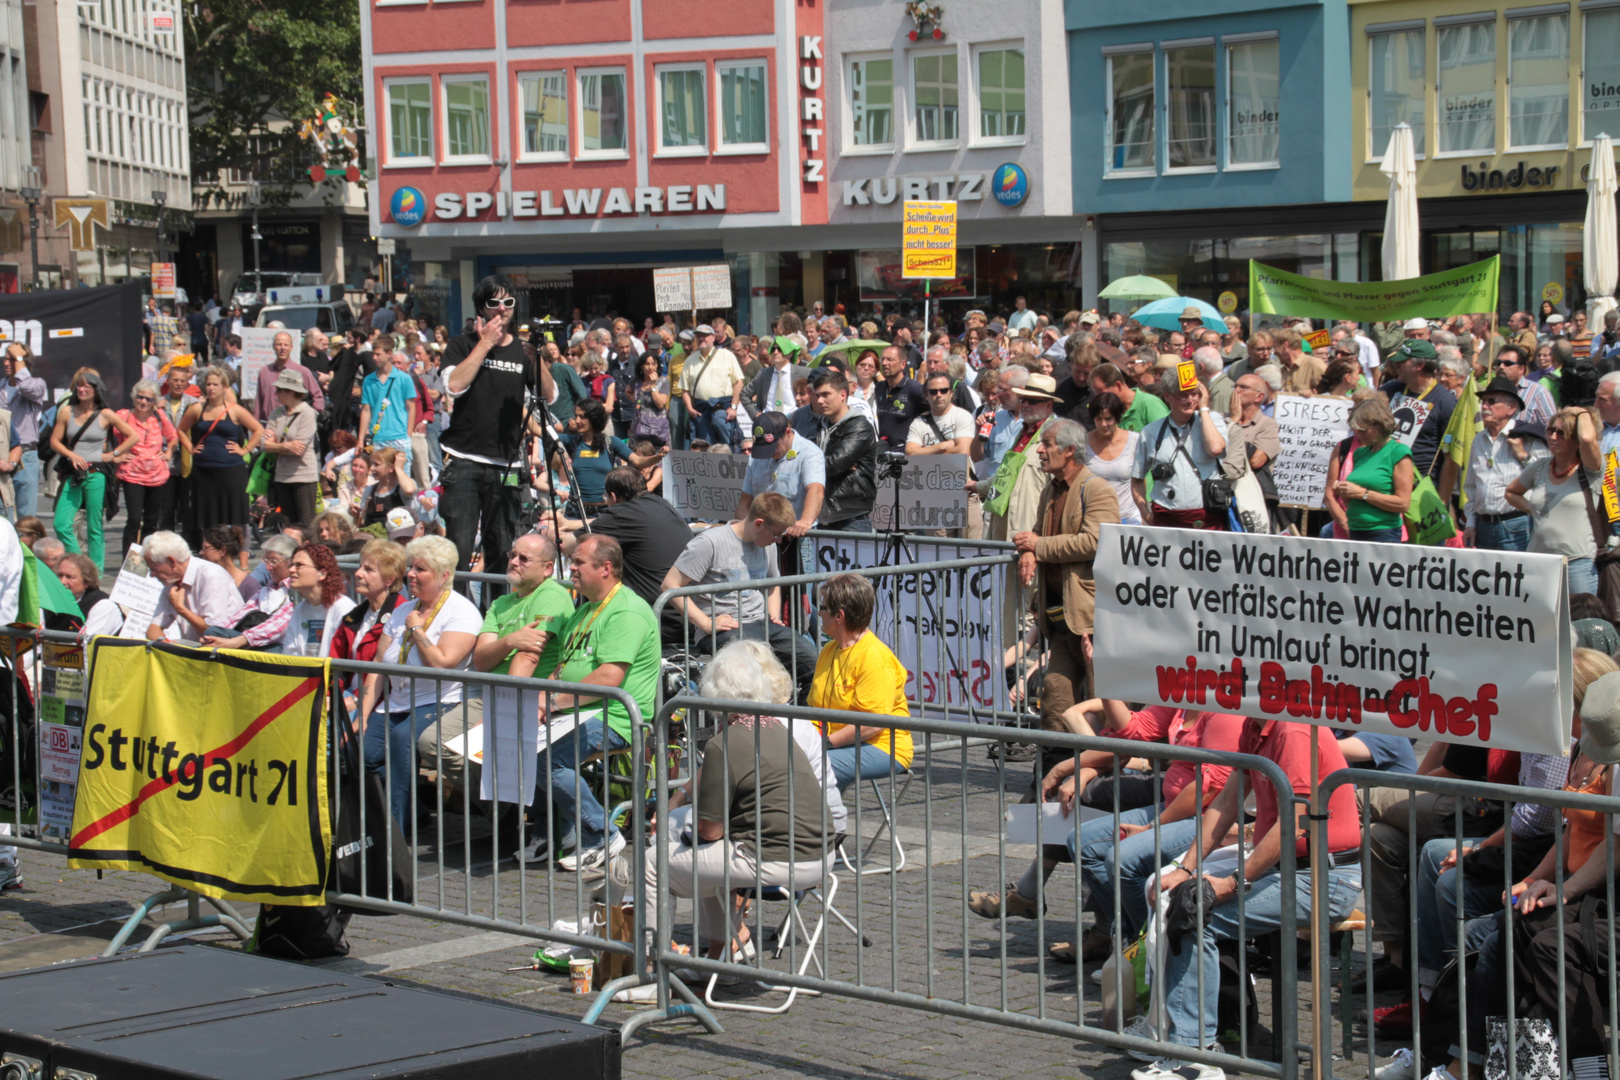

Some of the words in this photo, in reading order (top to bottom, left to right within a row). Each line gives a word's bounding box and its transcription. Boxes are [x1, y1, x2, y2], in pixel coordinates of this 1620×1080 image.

[1591, 82, 1620, 97] bin
[800, 36, 824, 182] KURTZ
[1446, 96, 1493, 111] binder
[1461, 161, 1559, 191] binder
[434, 183, 726, 219] SPIELWAREN
[843, 174, 984, 206] KURTZ
[996, 190, 1021, 200] vedes
[394, 210, 419, 221] vedes
[907, 212, 936, 222] Scheiße
[937, 213, 954, 222] wird
[906, 225, 928, 235] durch
[906, 239, 925, 249] nicht
[926, 239, 954, 249] besser!
[1383, 288, 1420, 301] gegen
[1422, 275, 1475, 293] Stuttgart
[1476, 272, 1488, 282] 21
[1280, 401, 1342, 423] STRESS
[1278, 424, 1306, 435] MACHT
[1277, 449, 1297, 458] ILE
[672, 454, 717, 478] auch
[926, 464, 967, 491] das
[1272, 470, 1316, 484] PROJEKT
[907, 499, 967, 527] durch
[1120, 535, 1171, 568] Wer
[1178, 540, 1222, 573] die
[1232, 544, 1360, 585] Wahrheit
[1368, 556, 1530, 603] verfälscht,
[1115, 576, 1179, 609] oder
[1188, 583, 1345, 625] verfälschte
[1353, 596, 1536, 644] Wahrheiten
[1197, 621, 1220, 654] in
[1231, 625, 1331, 665] Umlauf
[1340, 635, 1436, 681] bringt,
[1155, 656, 1243, 710] wird
[1259, 661, 1499, 742] Bahn-Chef
[52, 731, 67, 749] DB
[52, 764, 71, 777] Betrug
[85, 723, 258, 804] Stuttgart
[266, 759, 298, 806] 21
